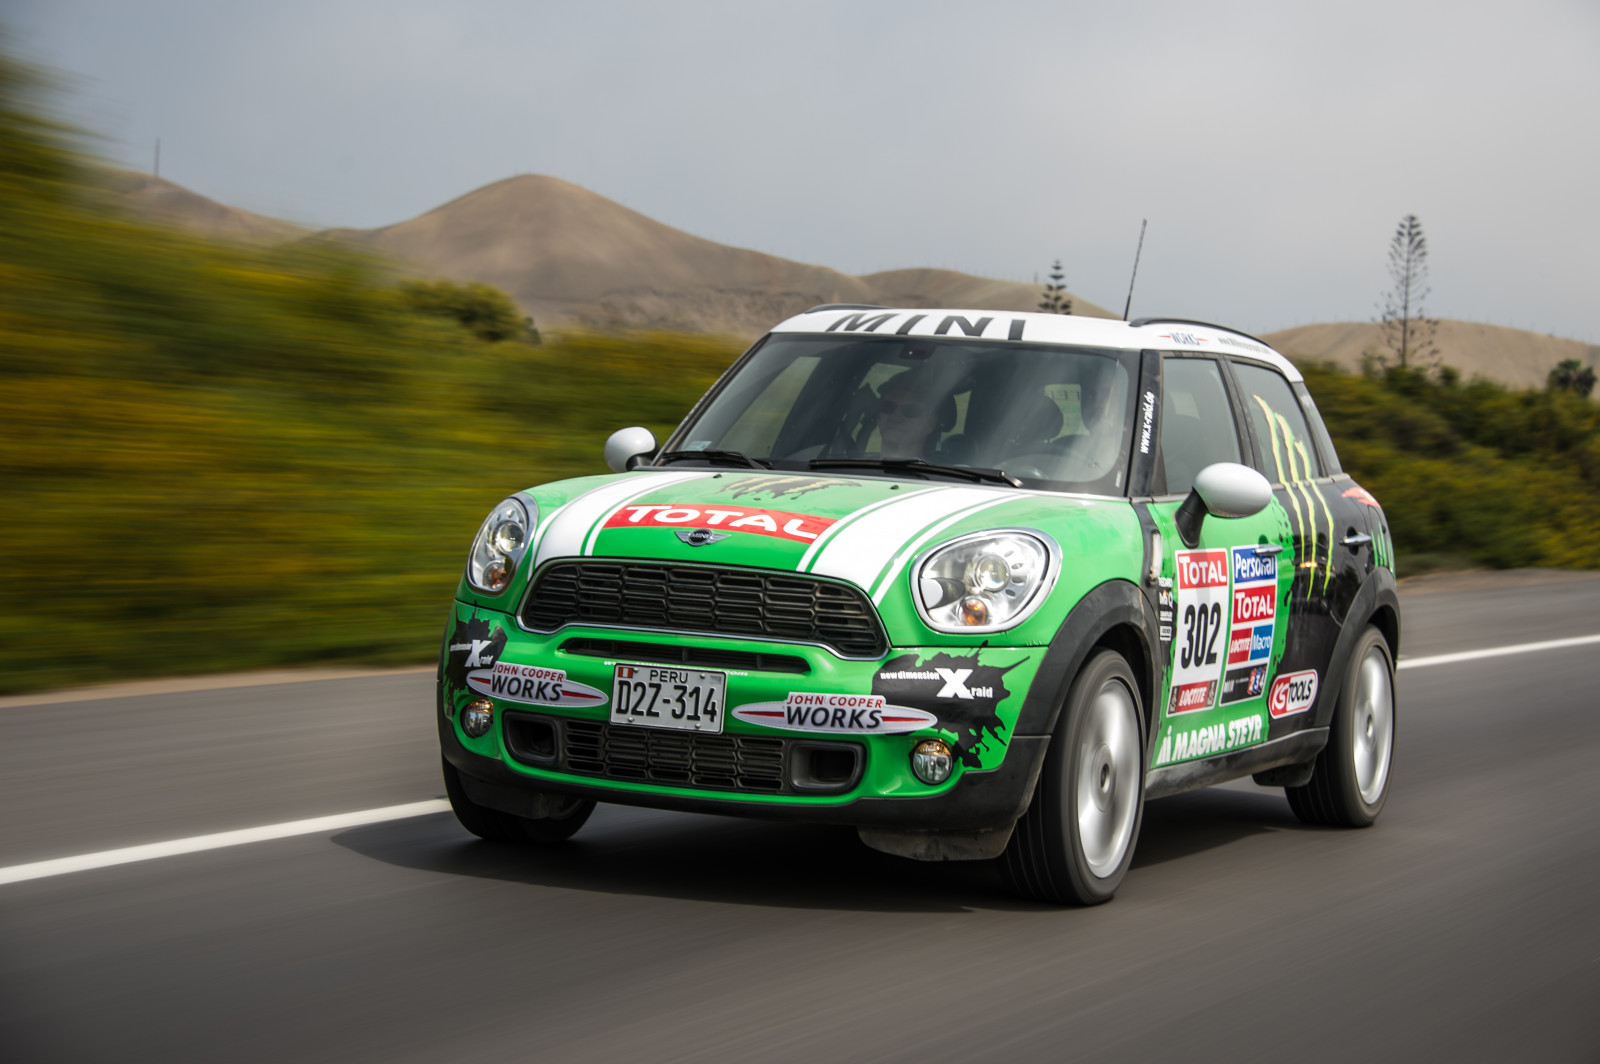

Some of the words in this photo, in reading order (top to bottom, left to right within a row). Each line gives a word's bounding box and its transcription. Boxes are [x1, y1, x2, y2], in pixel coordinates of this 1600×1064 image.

[825, 313, 1026, 341] MINI
[626, 505, 818, 539] TOTAL
[1179, 556, 1227, 585] TOTAL
[1235, 553, 1275, 579] Personal
[1235, 592, 1274, 619] TOTAL
[1181, 602, 1222, 669] 302
[1252, 634, 1272, 651] Macro
[492, 664, 519, 676] JOHN
[521, 667, 565, 682] COOPER
[649, 669, 689, 684] PERU
[491, 674, 563, 702] WORKS
[1179, 686, 1208, 706] LOCTITE
[1287, 679, 1313, 704] TOOLS
[615, 680, 718, 723] D2Z-314
[786, 695, 825, 706] JOHN
[829, 696, 884, 709] COOPER
[785, 705, 883, 730] WORKS
[1171, 723, 1226, 762] MAGNA
[1226, 714, 1263, 749] STEYR
